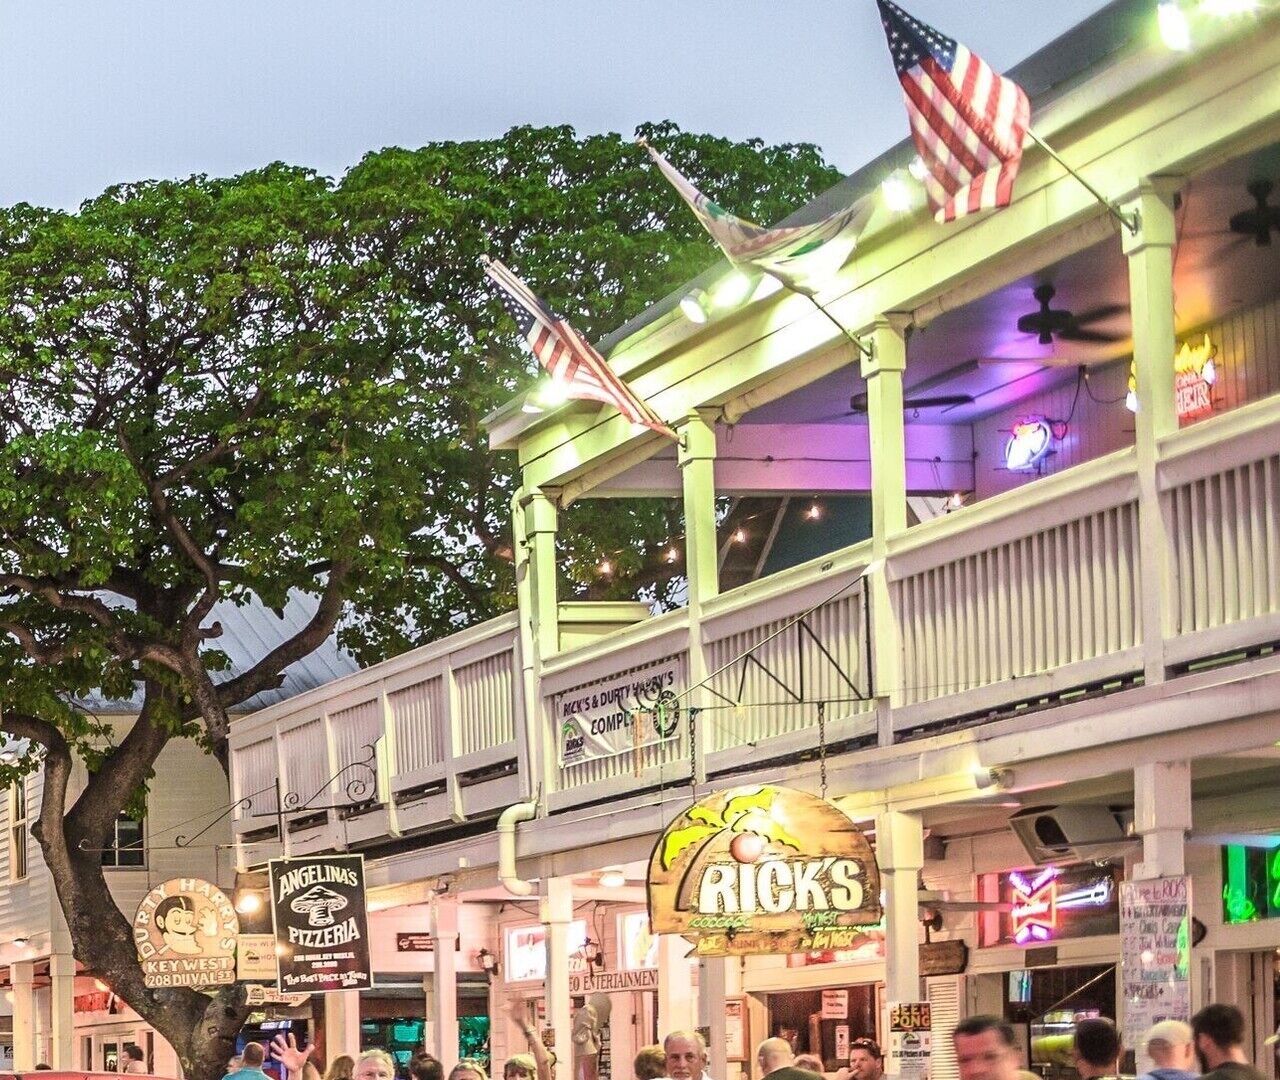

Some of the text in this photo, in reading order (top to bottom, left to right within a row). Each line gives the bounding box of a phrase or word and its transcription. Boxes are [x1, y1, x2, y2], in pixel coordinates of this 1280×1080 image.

[564, 698, 590, 717] RICK'S
[600, 684, 631, 707] DURTY
[591, 712, 634, 736] COMPL
[278, 865, 358, 904] ANGELINA'S
[698, 856, 864, 914] RICK'S
[135, 884, 168, 959] DURTY
[288, 917, 360, 947] PIZZERIA
[147, 957, 230, 973] KEY WEST
[149, 975, 172, 986] 208
[173, 972, 218, 986] DUVAL
[892, 1015, 930, 1028] PONG
